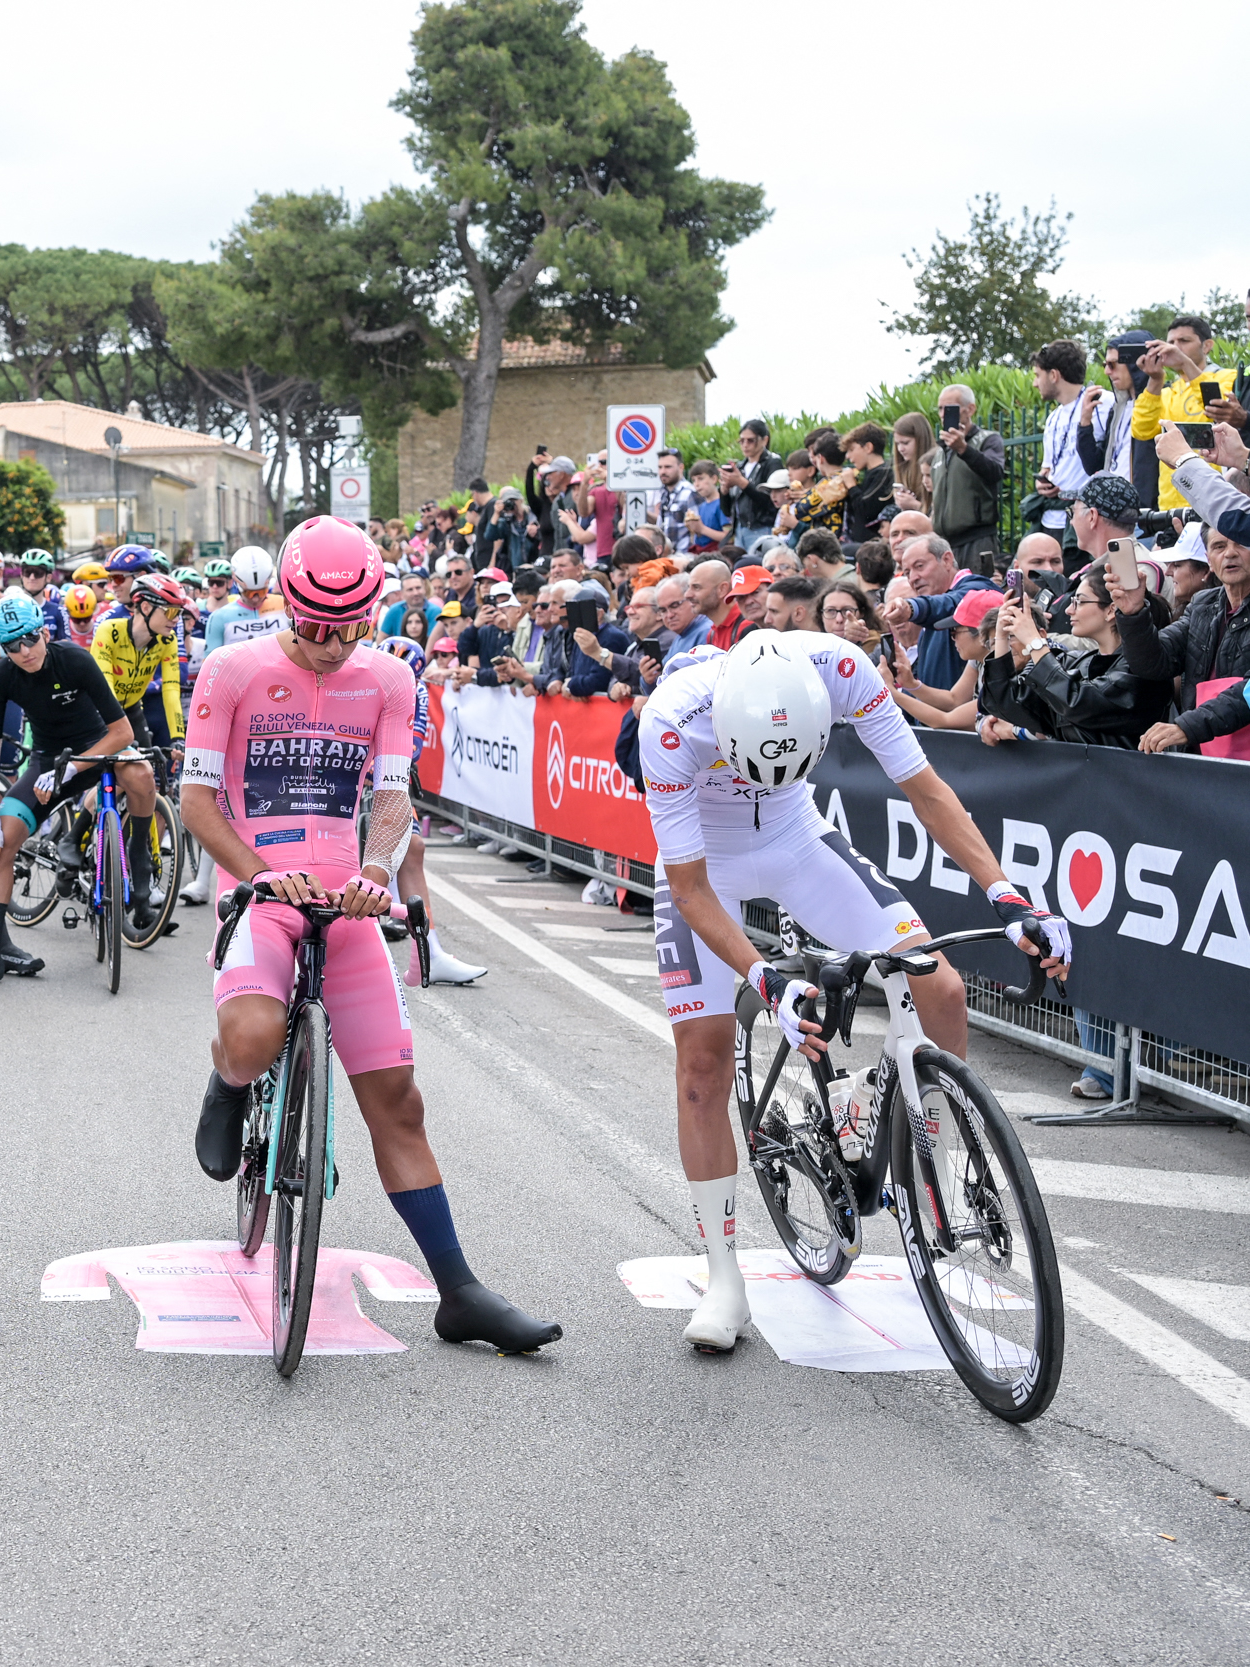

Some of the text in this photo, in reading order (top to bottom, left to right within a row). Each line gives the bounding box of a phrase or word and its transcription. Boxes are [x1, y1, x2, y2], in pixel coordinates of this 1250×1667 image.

[320, 571, 354, 580] AMACX
[863, 685, 890, 714] CONA
[251, 712, 306, 723] IO SONO
[250, 722, 371, 738] FRIULI VENEZIA GIULIA
[250, 739, 370, 760] BAHRAIN
[760, 738, 798, 759] G42
[250, 757, 362, 771] VICTORIOUS
[290, 802, 327, 810] Bianchi
[779, 910, 793, 950] 192
[668, 1001, 704, 1017] ONAD
[864, 1058, 889, 1159] COLNAGO
